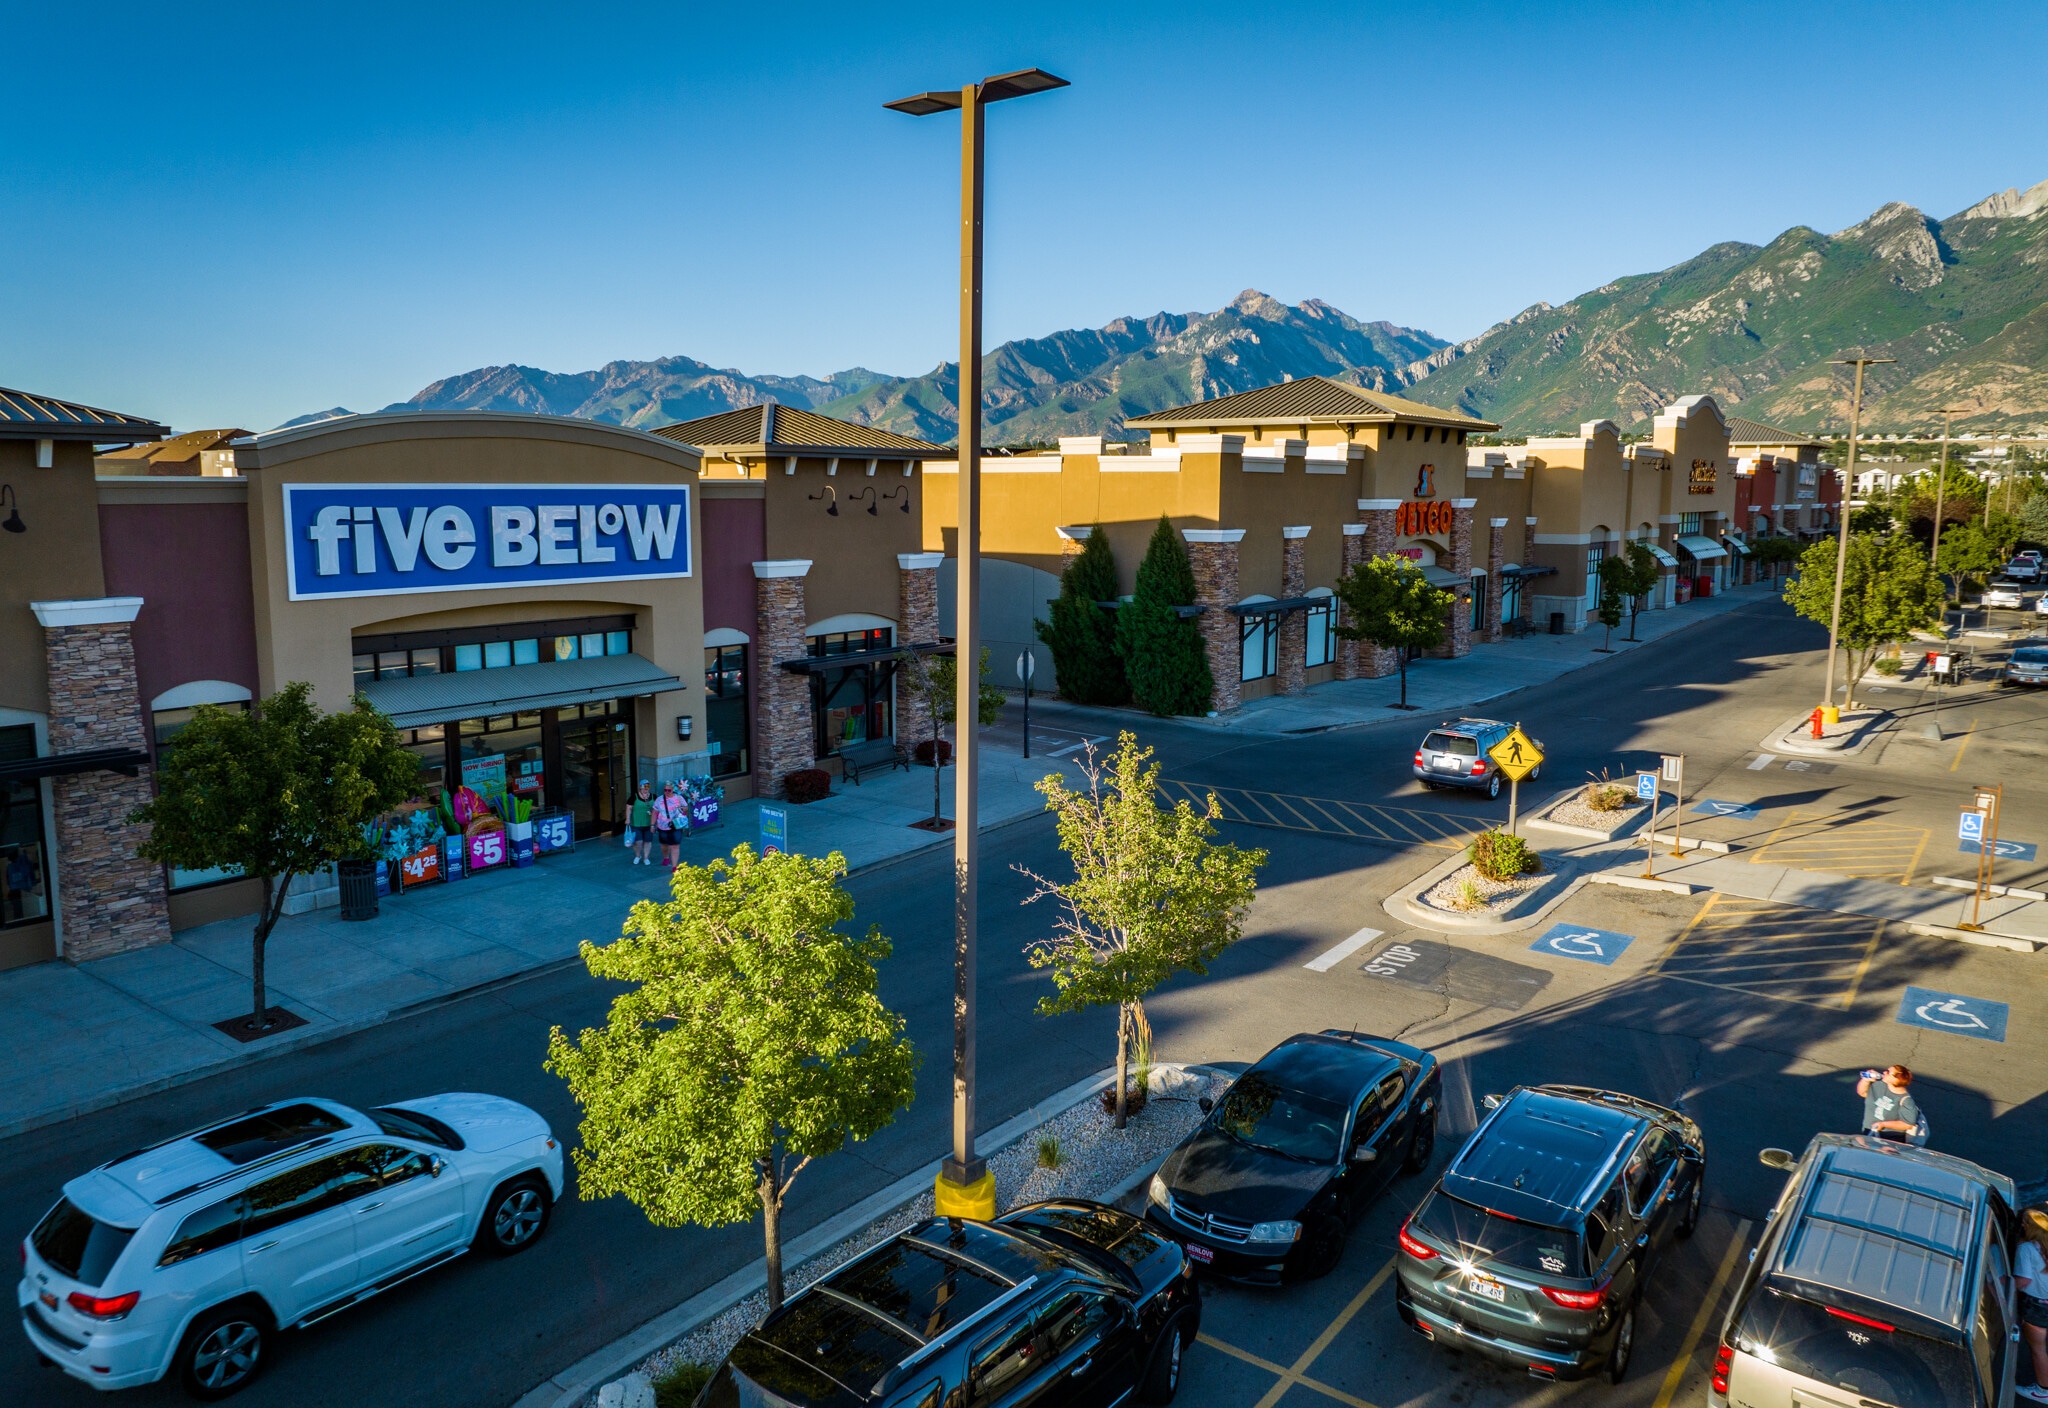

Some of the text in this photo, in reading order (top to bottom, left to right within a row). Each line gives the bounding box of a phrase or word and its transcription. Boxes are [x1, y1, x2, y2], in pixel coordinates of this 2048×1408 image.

[1396, 501, 1453, 537] PETCO
[307, 503, 681, 576] five BELOW
[542, 821, 568, 847] $5
[473, 837, 502, 864] $5
[1364, 945, 1421, 976] STOP
[1187, 1243, 1214, 1259] MENLOVE
